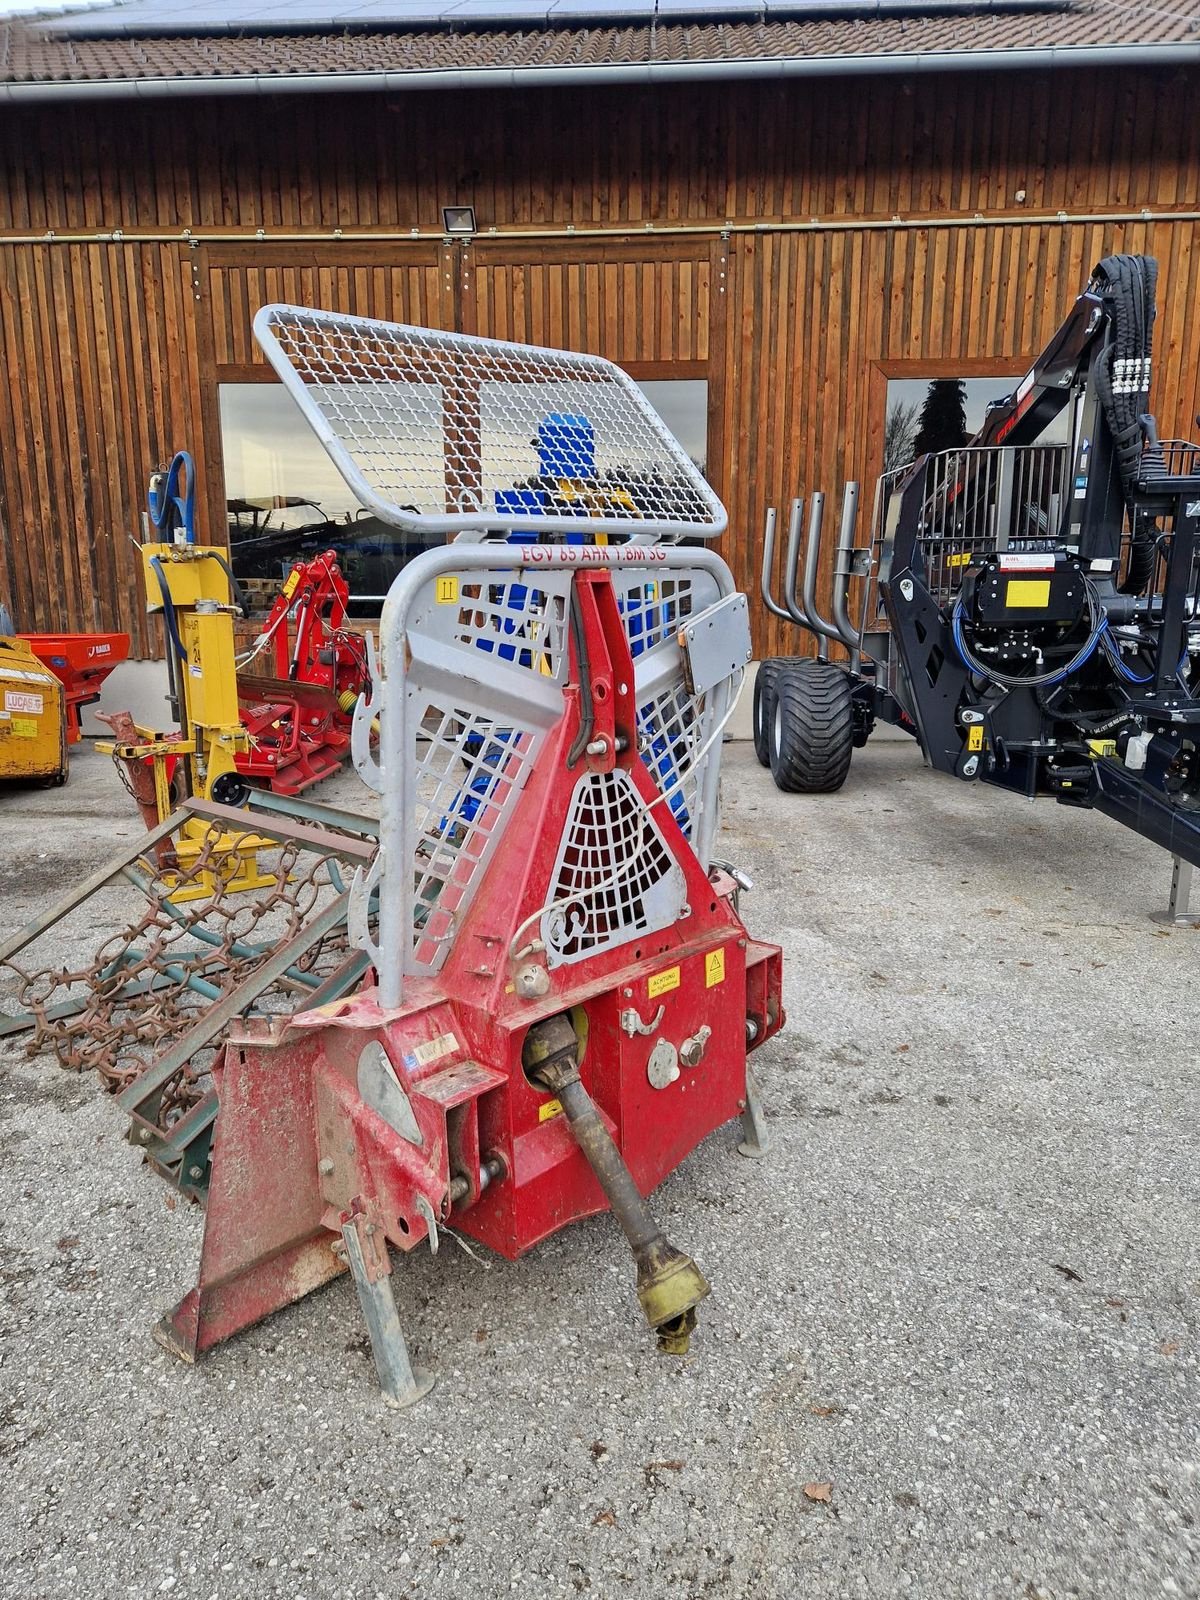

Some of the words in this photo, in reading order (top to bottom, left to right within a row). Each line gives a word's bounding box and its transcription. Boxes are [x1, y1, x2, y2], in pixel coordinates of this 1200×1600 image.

[521, 546, 553, 561] EGV
[560, 546, 577, 561] 65
[581, 546, 610, 561] AHK
[7, 695, 33, 708] LUCAS
